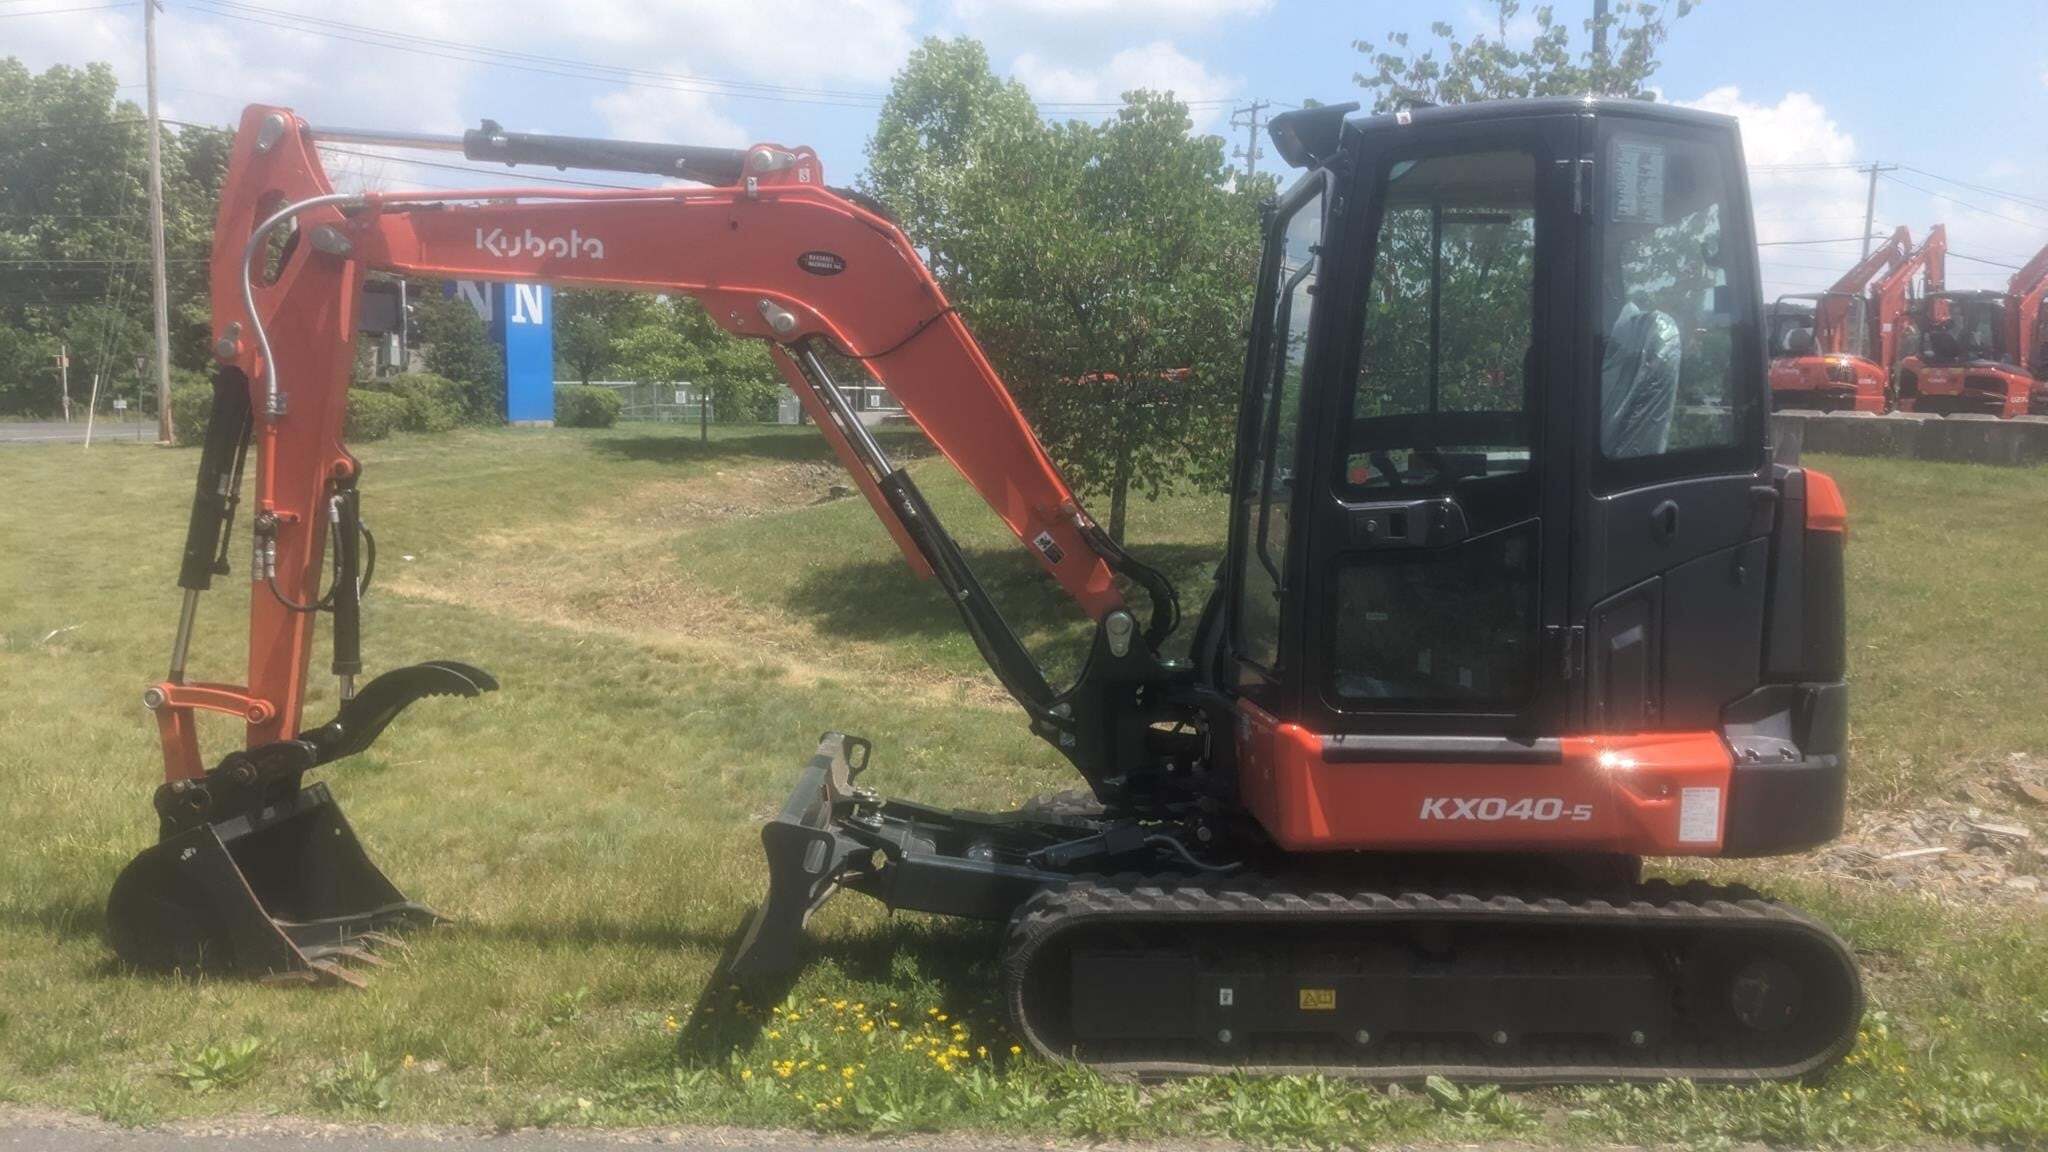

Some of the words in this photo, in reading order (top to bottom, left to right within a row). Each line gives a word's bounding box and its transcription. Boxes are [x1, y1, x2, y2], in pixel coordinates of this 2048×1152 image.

[476, 228, 604, 258] Kubota
[512, 283, 543, 324] N
[1419, 798, 1593, 821] KX040-5
